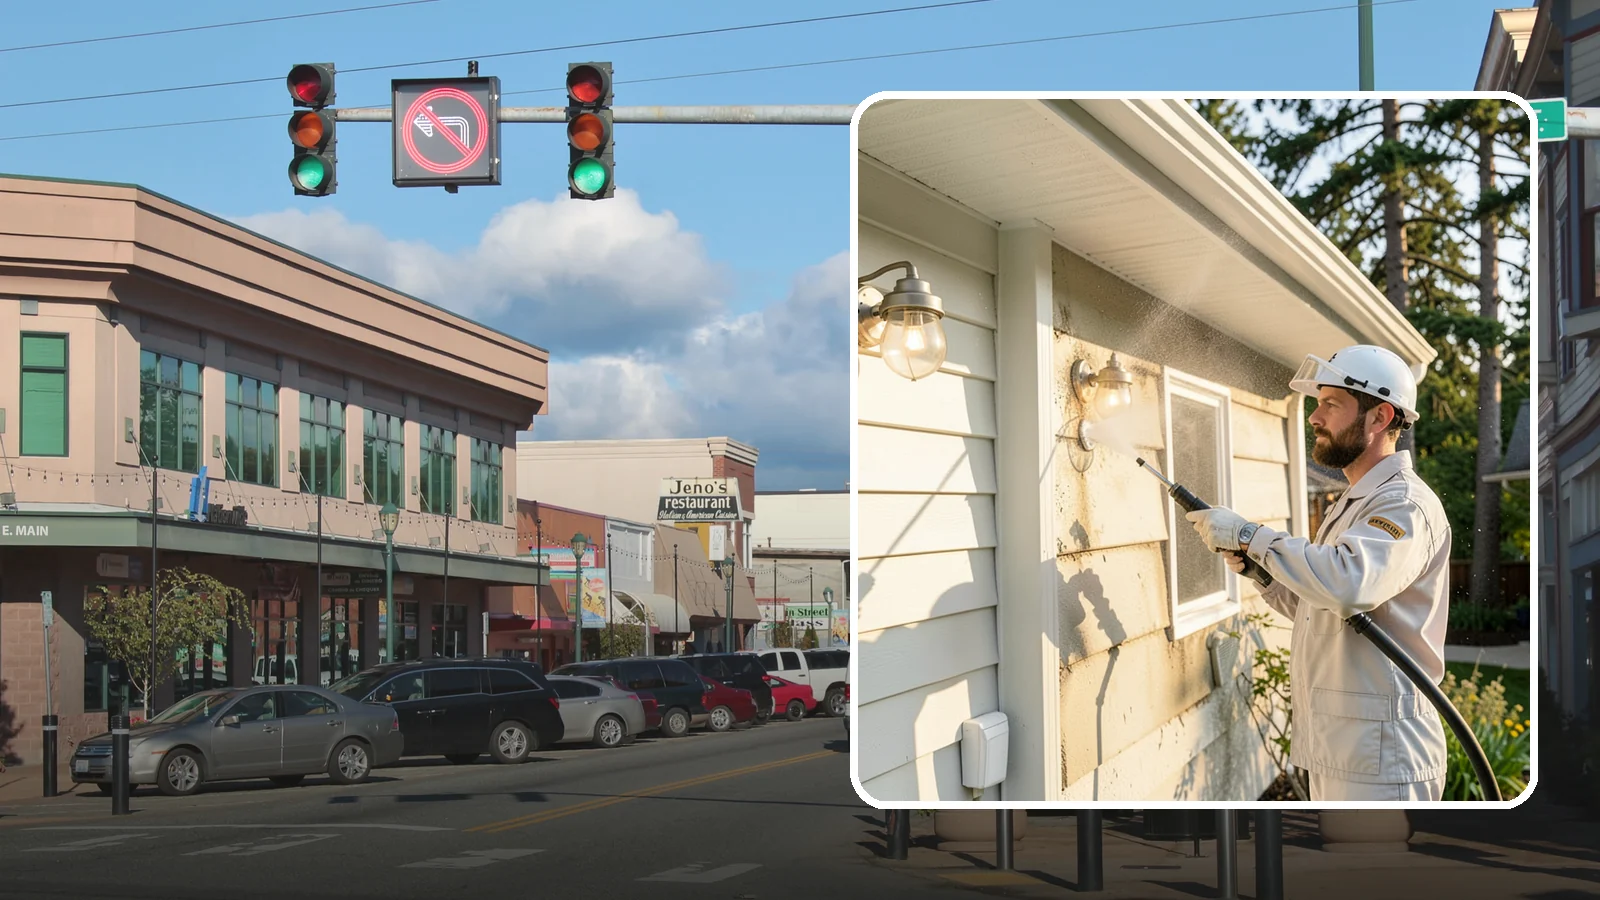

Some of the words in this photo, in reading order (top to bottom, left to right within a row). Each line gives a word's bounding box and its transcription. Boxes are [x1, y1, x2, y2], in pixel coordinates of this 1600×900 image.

[670, 480, 727, 494] Jeno's
[665, 497, 731, 509] restaurant
[686, 510, 714, 519] American
[715, 509, 738, 519] Cuisine
[2, 525, 13, 536] E.
[16, 525, 49, 536] MAIN
[797, 607, 828, 617] Street
